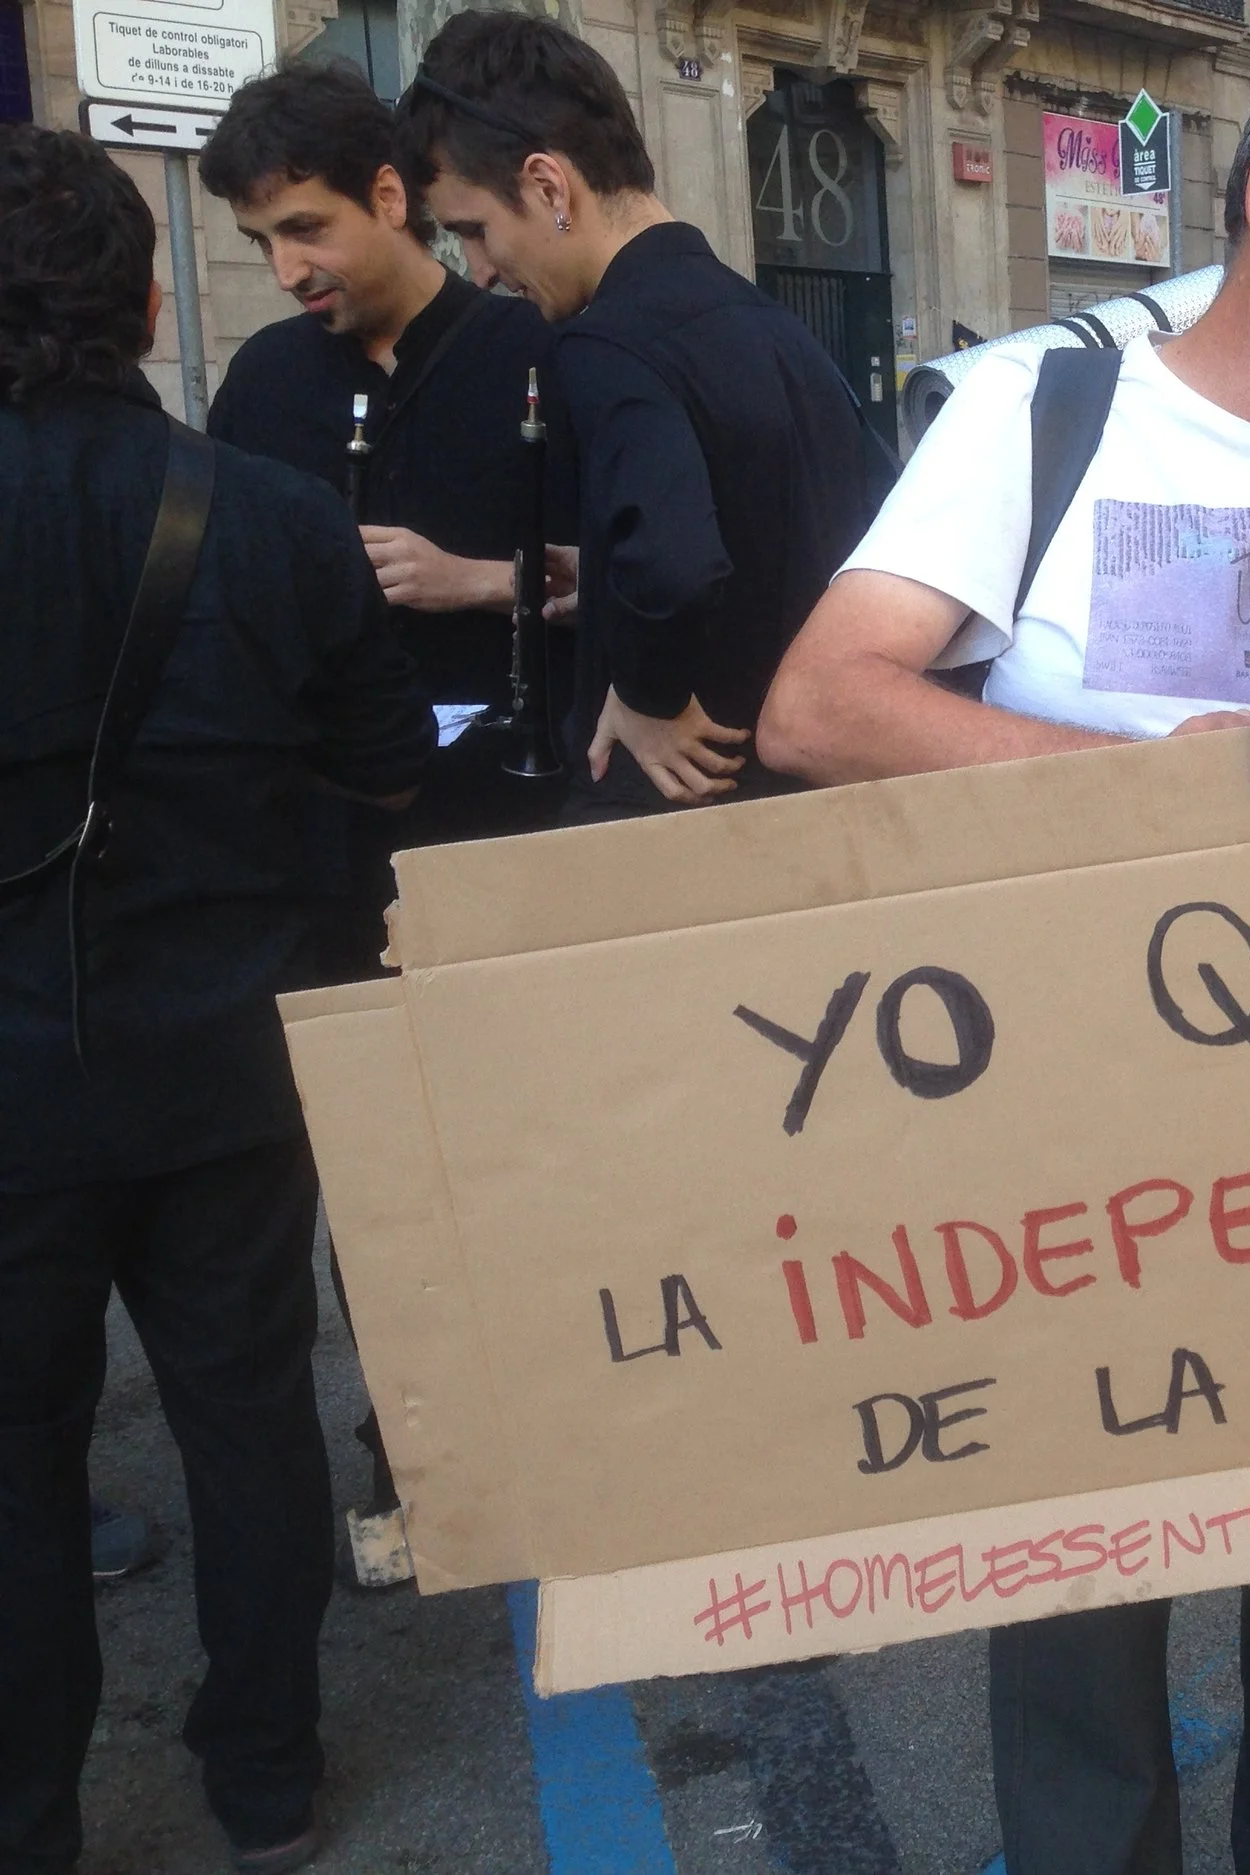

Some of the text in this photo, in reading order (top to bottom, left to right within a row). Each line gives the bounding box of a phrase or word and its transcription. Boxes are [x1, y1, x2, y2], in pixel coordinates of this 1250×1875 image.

[108, 21, 248, 49] Tiquet de control obligatori
[152, 43, 209, 60] Laborables
[128, 56, 235, 79] de dilluns a dissabte
[681, 60, 698, 78] 48
[148, 74, 171, 87] 9-14
[181, 79, 194, 89] de
[198, 80, 225, 93] 16-20
[228, 83, 234, 94] h
[756, 124, 854, 246] 48
[733, 965, 996, 1137] YO
[599, 1274, 722, 1363] LA
[852, 1377, 997, 1475] DE
[1095, 1347, 1227, 1436] LA
